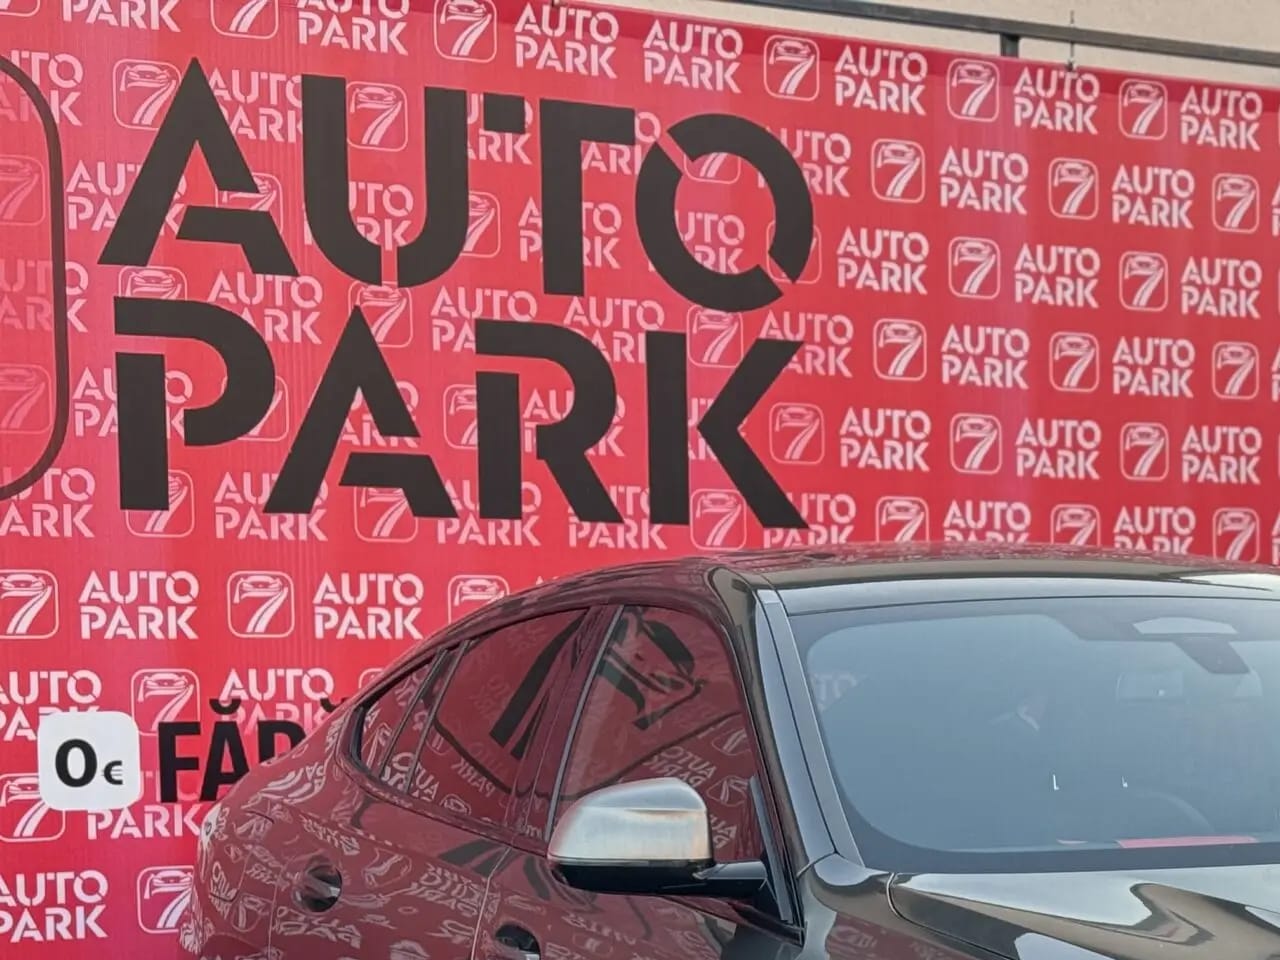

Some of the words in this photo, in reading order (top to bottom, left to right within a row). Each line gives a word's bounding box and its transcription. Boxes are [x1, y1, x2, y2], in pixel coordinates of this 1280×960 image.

[299, 21, 407, 54] PARK
[515, 3, 619, 44] AUTO
[643, 19, 743, 59] AUTO
[516, 35, 616, 78] PARK
[644, 51, 740, 93] PARK
[835, 44, 928, 82] AUTO
[836, 75, 925, 115] PARK
[1013, 66, 1100, 102] AUTO
[1014, 96, 1097, 134] PARK
[1180, 86, 1263, 120] AUTO
[1181, 114, 1260, 151] PARK
[940, 148, 1028, 183] AUTO
[1112, 166, 1194, 198] AUTO
[97, 56, 815, 313] AUTO
[941, 177, 1026, 214] PARK
[1113, 194, 1192, 228] PARK
[837, 228, 929, 262] AUTO
[1015, 244, 1100, 277] AUTO
[207, 270, 323, 309] AUTO
[839, 258, 926, 294] PARK
[1181, 258, 1262, 288] AUTO
[430, 285, 538, 322] AUTO
[1015, 273, 1097, 308] PARK
[1182, 285, 1259, 318] PARK
[563, 296, 665, 331] AUTO
[759, 310, 855, 345] AUTO
[942, 325, 1029, 358] AUTO
[1113, 337, 1195, 368] AUTO
[942, 354, 1027, 389] PARK
[1113, 366, 1192, 397] PARK
[113, 294, 807, 530] PARK
[840, 408, 931, 440] AUTO
[1016, 419, 1101, 449] AUTO
[1182, 426, 1261, 455] AUTO
[841, 438, 929, 471] PARK
[1017, 447, 1099, 479] PARK
[1182, 454, 1259, 483] PARK
[944, 501, 1031, 528] AUTO
[1114, 507, 1195, 535] AUTO
[80, 571, 198, 603] AUTO
[314, 574, 423, 605] AUTO
[81, 606, 197, 639] PARK
[315, 606, 422, 639] PARK
[219, 668, 334, 703] AUTO
